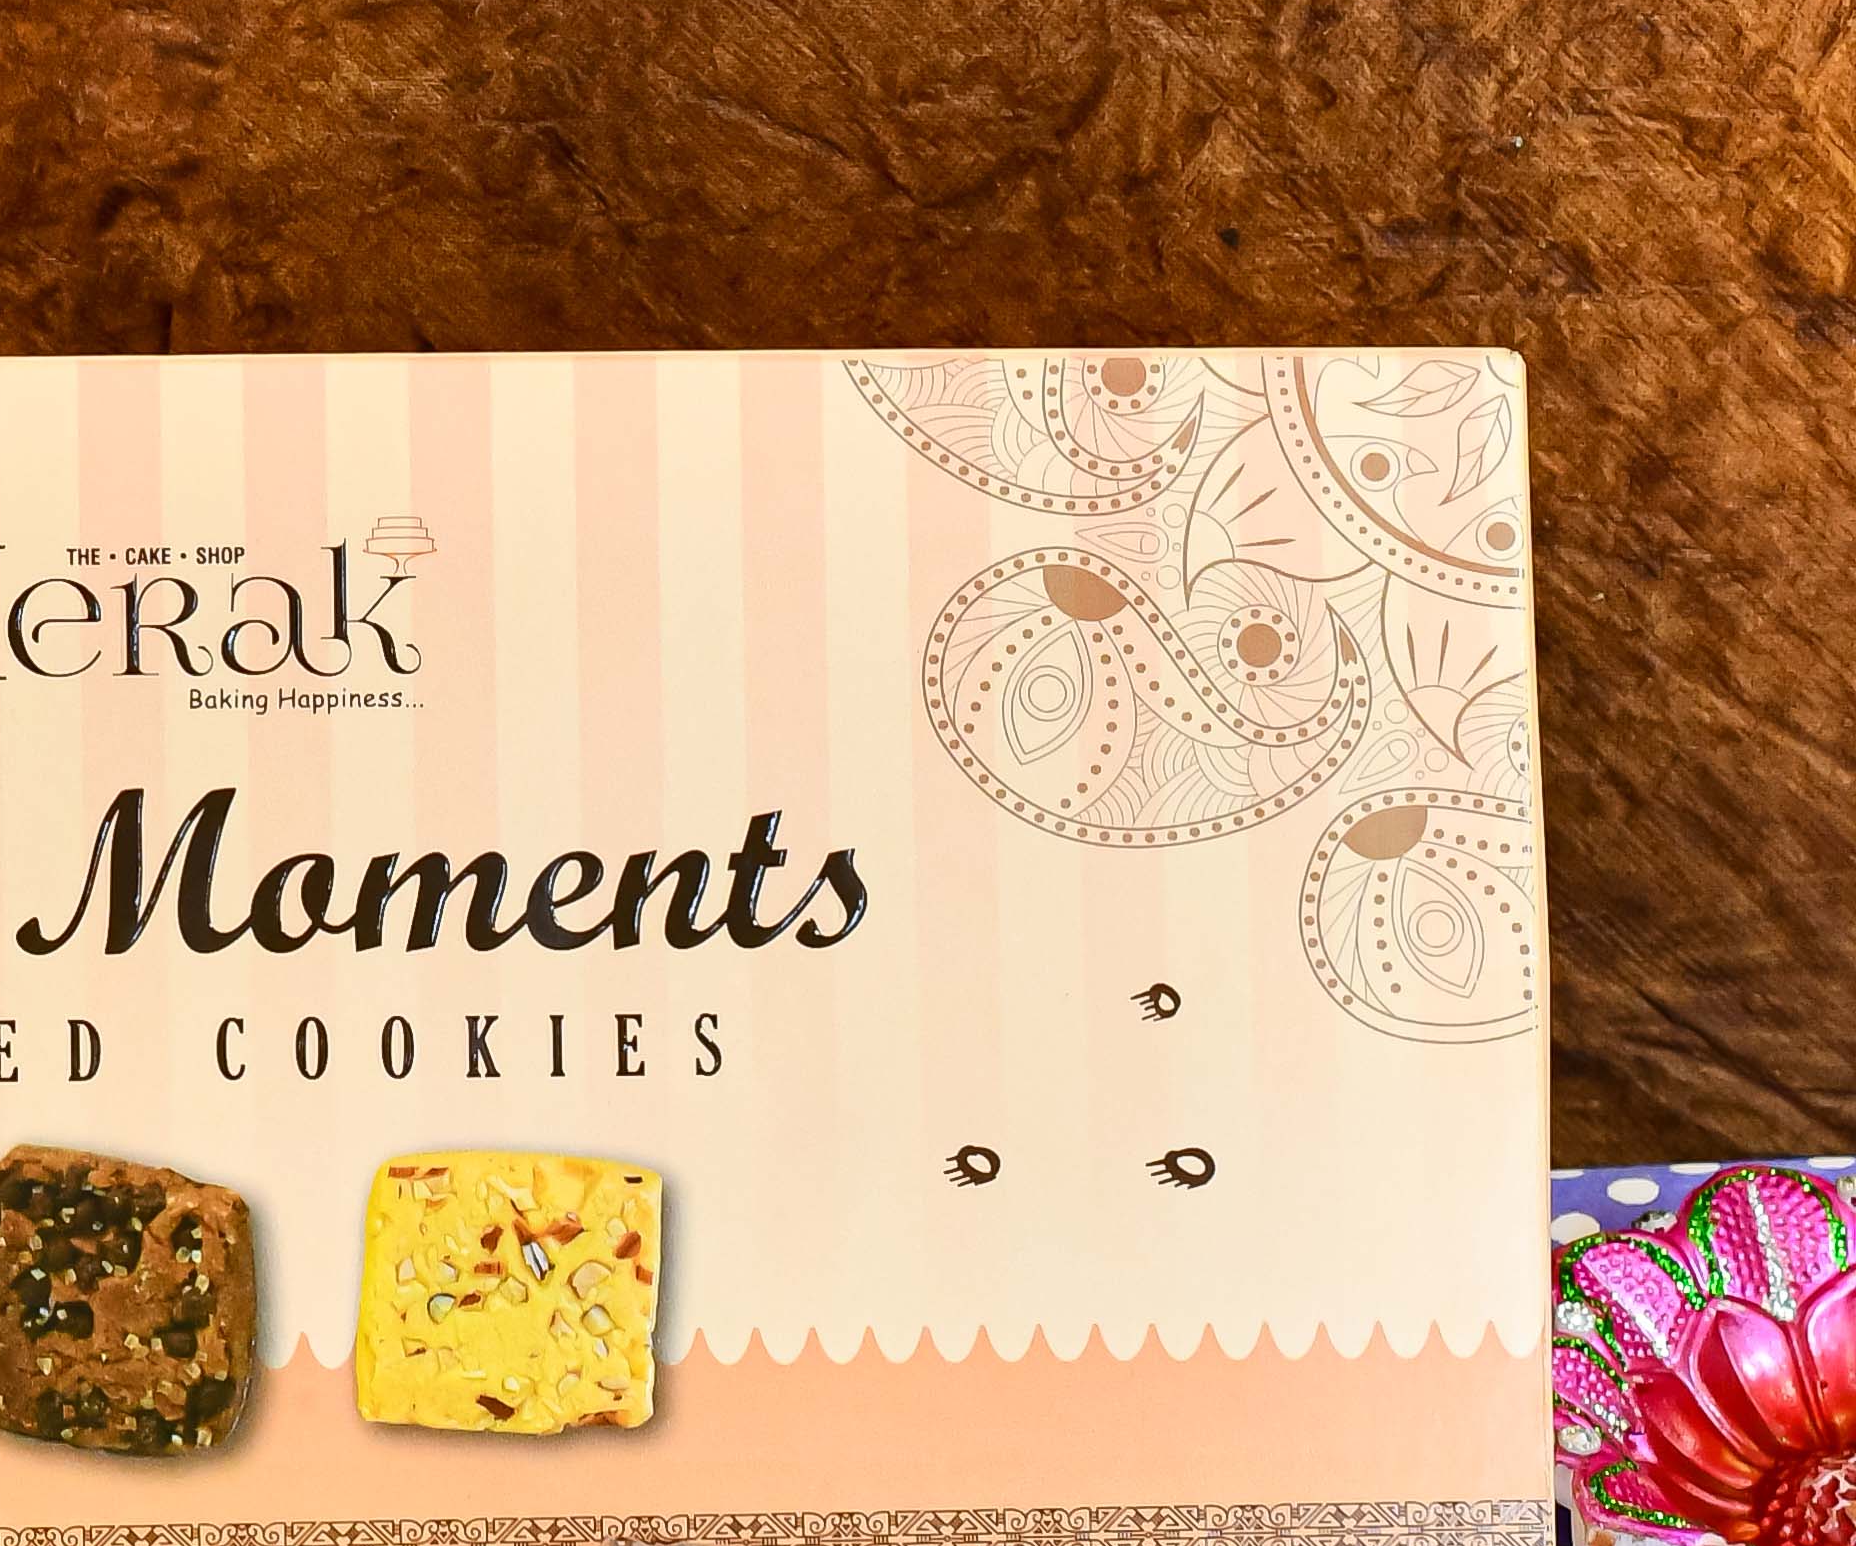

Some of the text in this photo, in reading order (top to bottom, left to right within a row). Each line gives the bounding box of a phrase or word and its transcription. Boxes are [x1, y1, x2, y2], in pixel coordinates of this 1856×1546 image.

[66, 545, 246, 566] THE CAKE SHOP
[188, 688, 426, 716] Baking Happiness...
[16, 786, 870, 958] Moments
[215, 1012, 726, 1083] COOKIES
